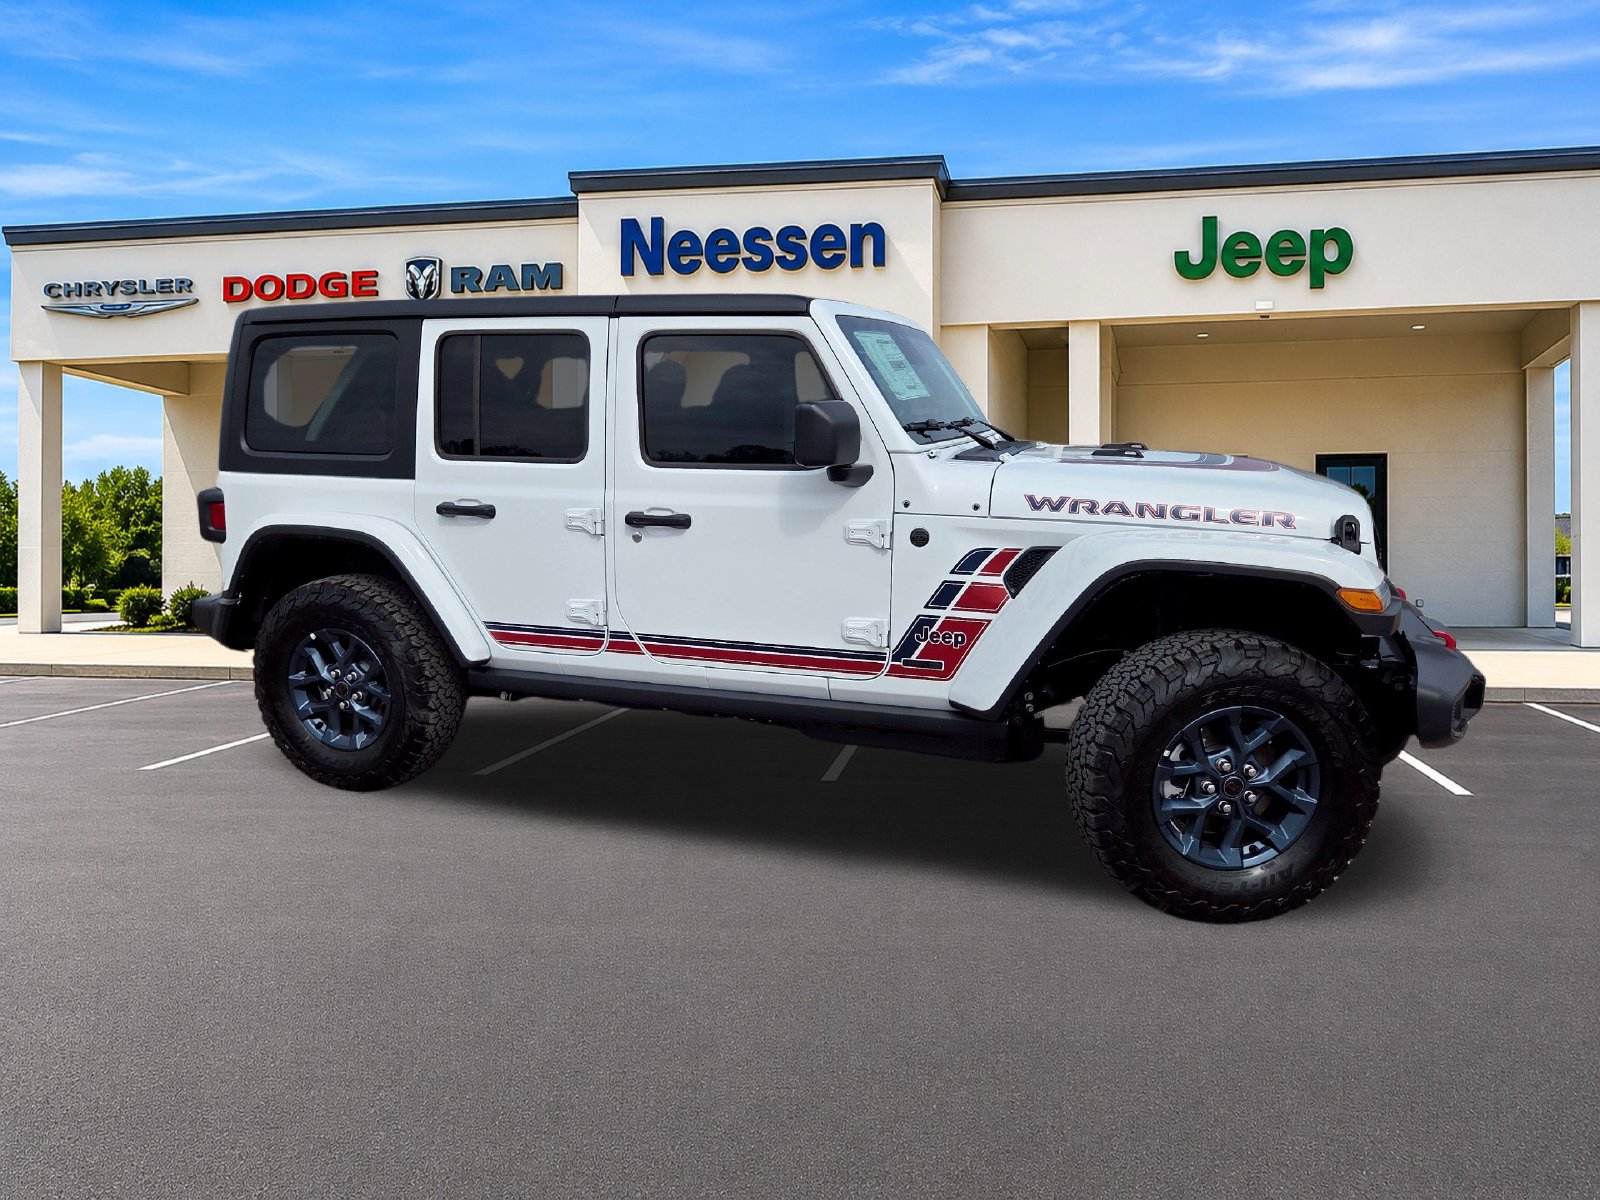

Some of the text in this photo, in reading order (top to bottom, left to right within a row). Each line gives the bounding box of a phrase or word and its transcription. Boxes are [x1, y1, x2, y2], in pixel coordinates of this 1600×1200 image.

[620, 216, 886, 276] Neessen
[1174, 216, 1354, 289] Jeep
[43, 277, 194, 300] CHRYSLER
[222, 269, 379, 303] DODGE
[450, 262, 563, 294] RAM
[1024, 494, 1297, 530] WRANGLER
[914, 625, 967, 649] Jeep
